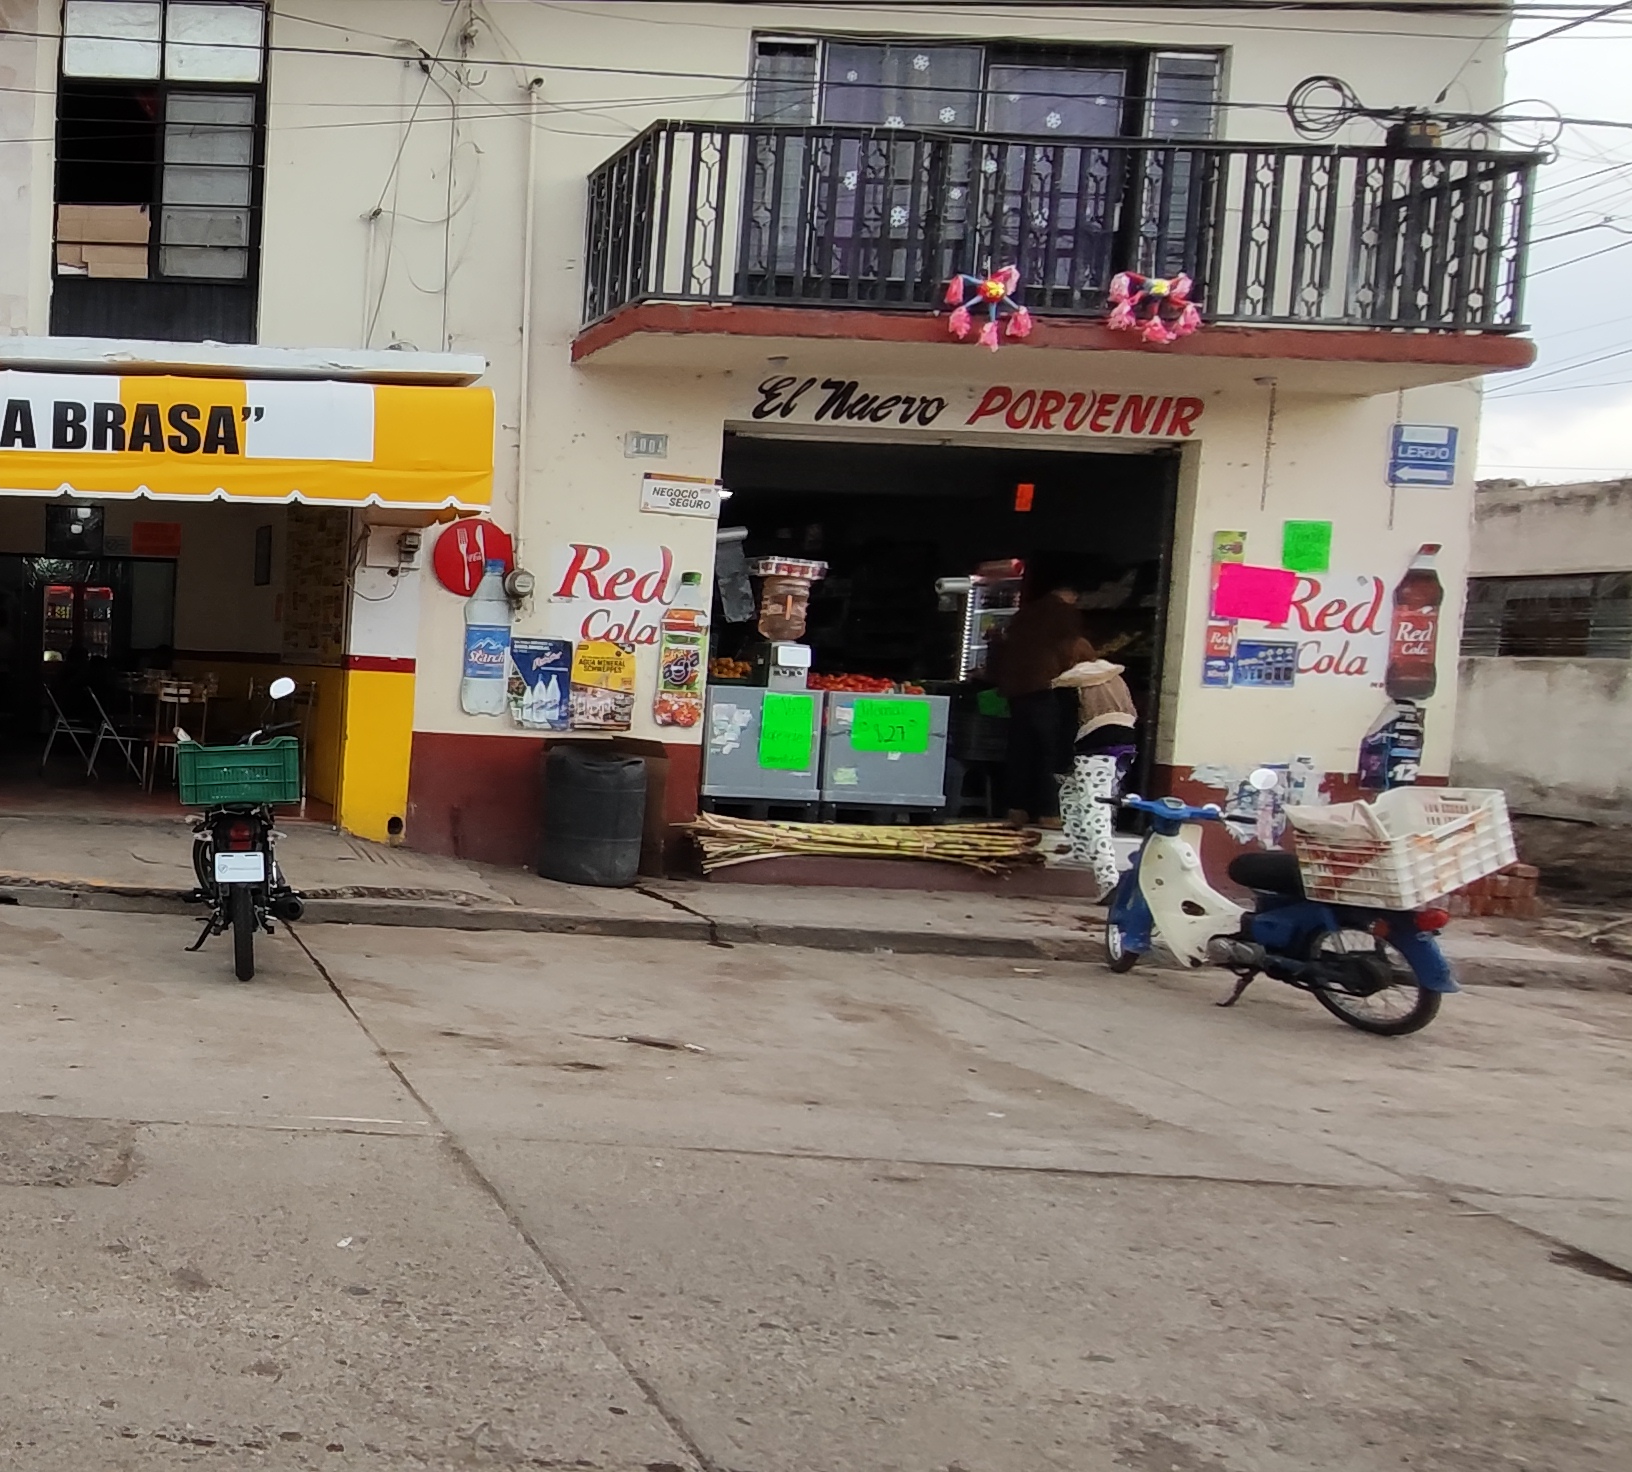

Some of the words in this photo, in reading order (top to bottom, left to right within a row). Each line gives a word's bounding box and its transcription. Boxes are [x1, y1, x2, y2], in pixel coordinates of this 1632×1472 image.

[752, 375, 817, 421] El
[813, 380, 950, 427] Nuevo
[965, 385, 1205, 437] PORVENIR
[51, 400, 265, 455] BRASA"
[1398, 445, 1450, 460] LERDO
[652, 486, 699, 500] NEGOCIO
[668, 497, 712, 510] SEGURO
[552, 543, 674, 606] Red
[1263, 575, 1386, 636] Red
[581, 608, 660, 645] Cola
[1395, 621, 1434, 642] Red
[1296, 640, 1371, 676] Cola
